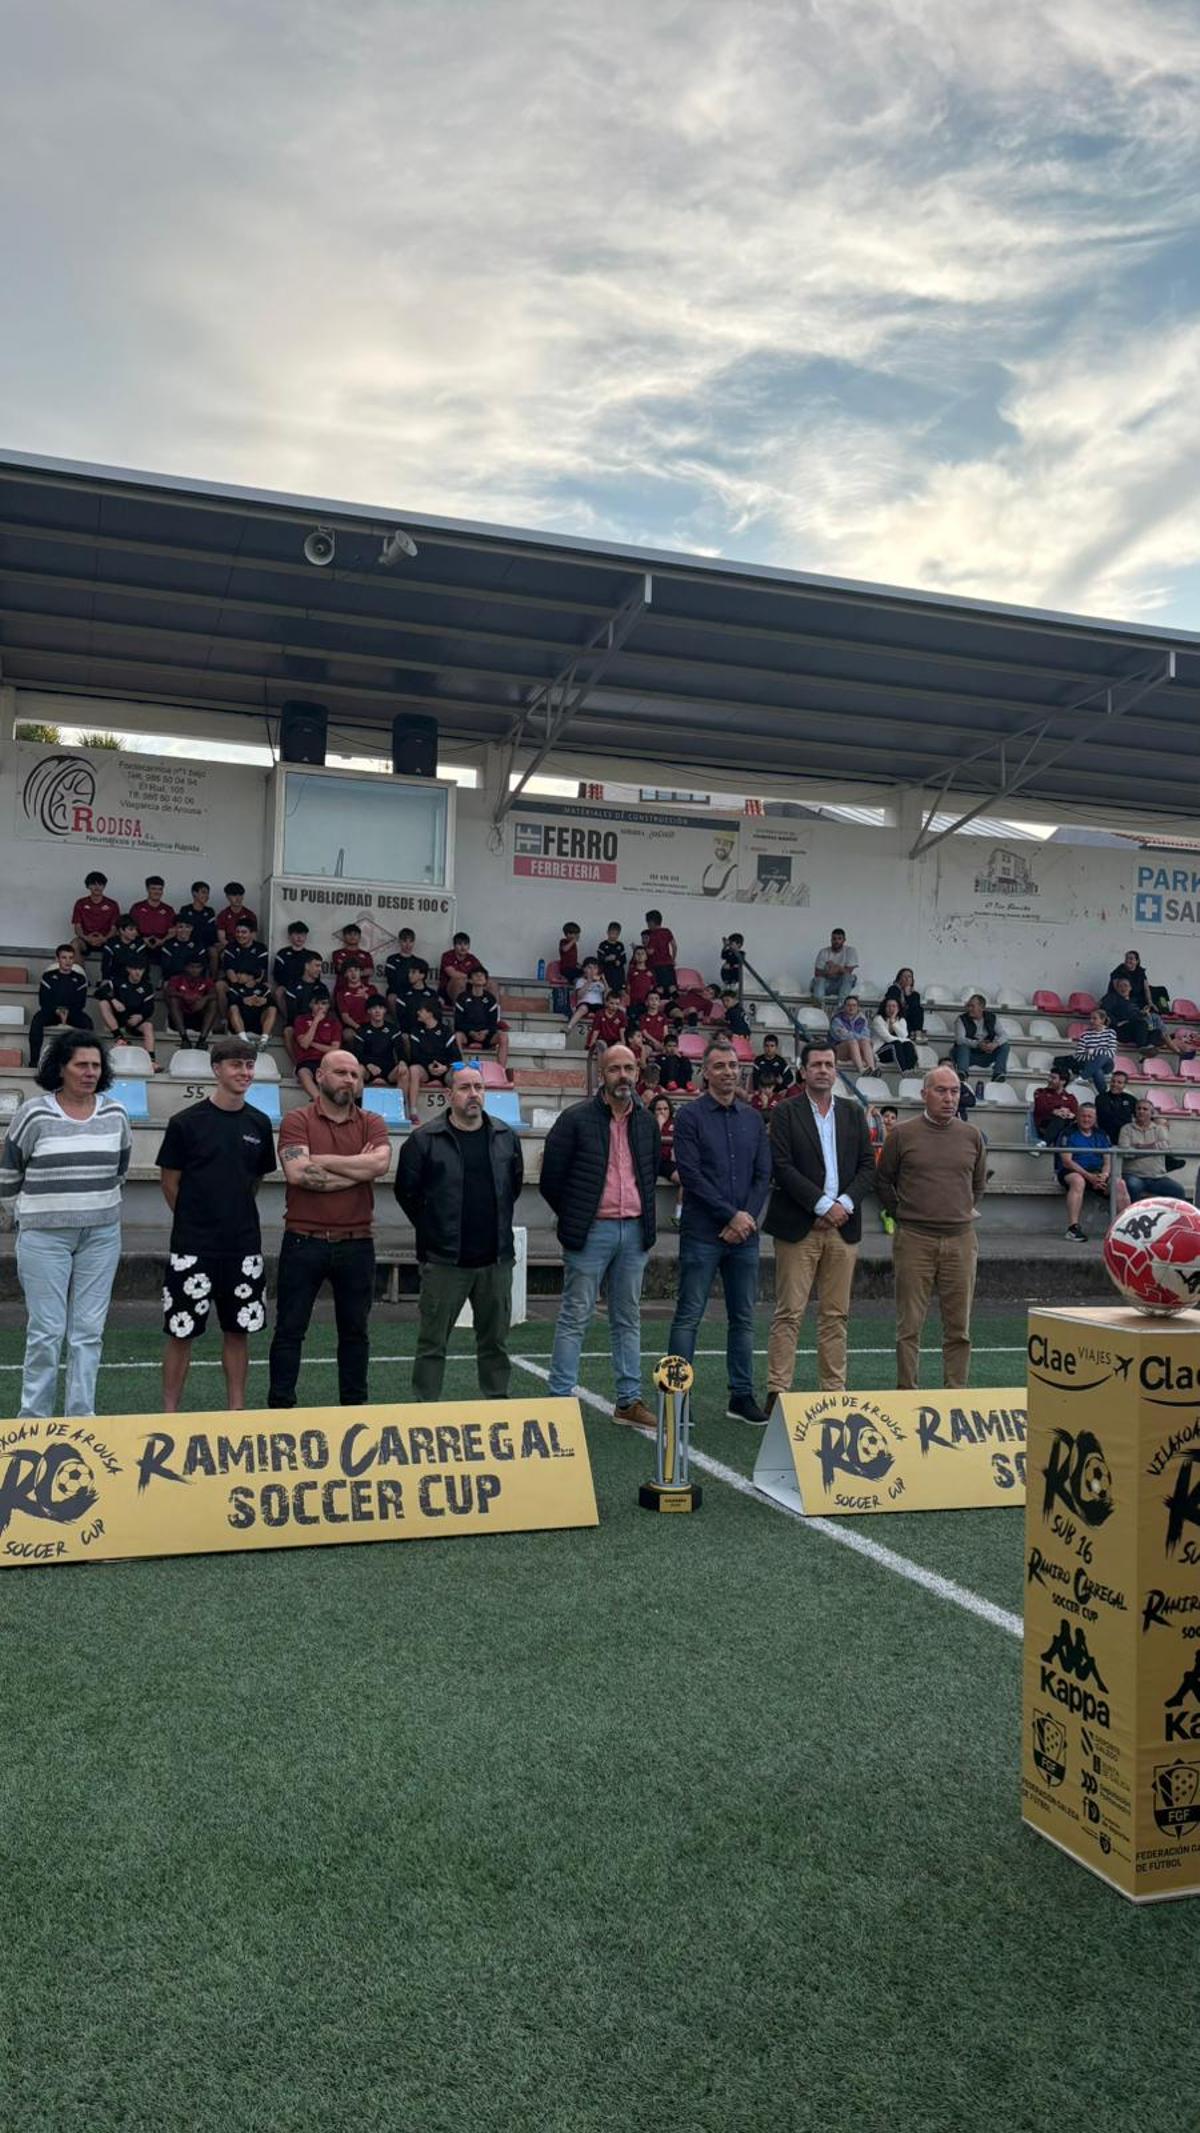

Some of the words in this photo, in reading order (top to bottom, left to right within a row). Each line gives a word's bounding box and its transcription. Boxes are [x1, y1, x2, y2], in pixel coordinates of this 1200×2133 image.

[543, 824, 618, 863] FERRO
[282, 887, 298, 901] TU
[300, 889, 373, 908] PUBLICIDAD
[377, 895, 415, 911] DESDE
[418, 899, 438, 913] 100
[439, 900, 449, 914] €
[183, 1085, 205, 1099] 55
[427, 1094, 446, 1108] 59
[1027, 1334, 1077, 1375] Clae
[1077, 1346, 1112, 1366] VIAJES
[1139, 1355, 1200, 1391] Cla
[841, 1396, 858, 1408] DE
[46, 1422, 70, 1437] DE
[69, 1428, 124, 1475] AROUSA
[913, 1405, 1028, 1457] RAMIR
[136, 1432, 330, 1497] RAMIRO
[340, 1419, 576, 1478] CARREGAL
[227, 1474, 406, 1530] SOCCER
[418, 1473, 502, 1518] CUP
[834, 1493, 883, 1509] SOCCER
[2, 1540, 69, 1559] SOCCER
[1050, 1514, 1077, 1546] SUB
[1075, 1535, 1094, 1565] 16
[1040, 1665, 1110, 1730] Kappa
[1168, 1808, 1191, 1824] FGF
